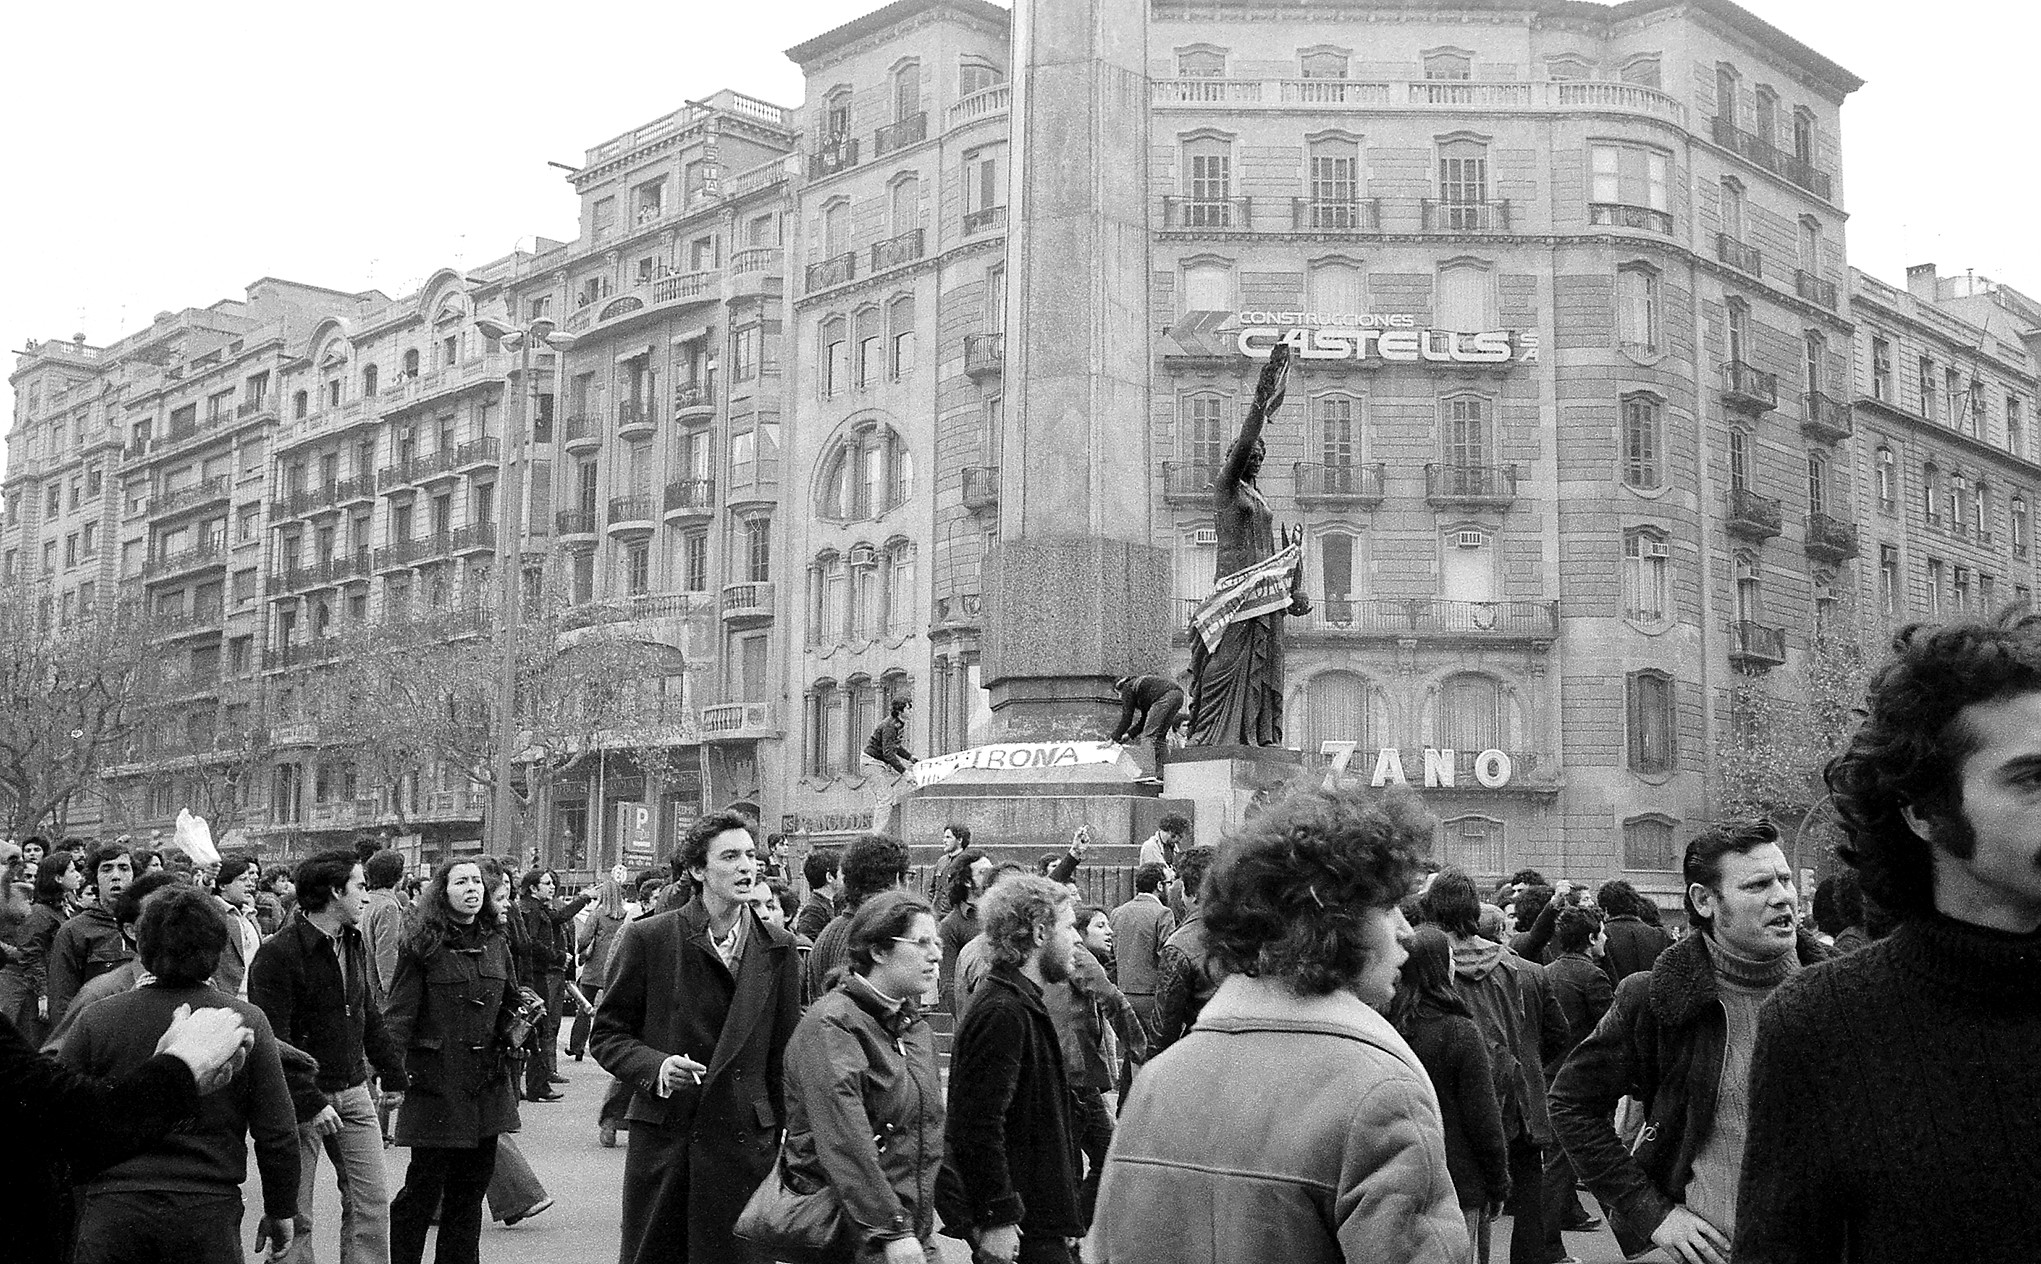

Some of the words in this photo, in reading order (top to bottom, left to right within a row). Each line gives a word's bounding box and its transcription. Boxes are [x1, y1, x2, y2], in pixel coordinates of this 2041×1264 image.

[1239, 311, 1415, 328] CONSTRUCCIONES
[1237, 328, 1512, 362] CASTELLS
[636, 807, 648, 829] P
